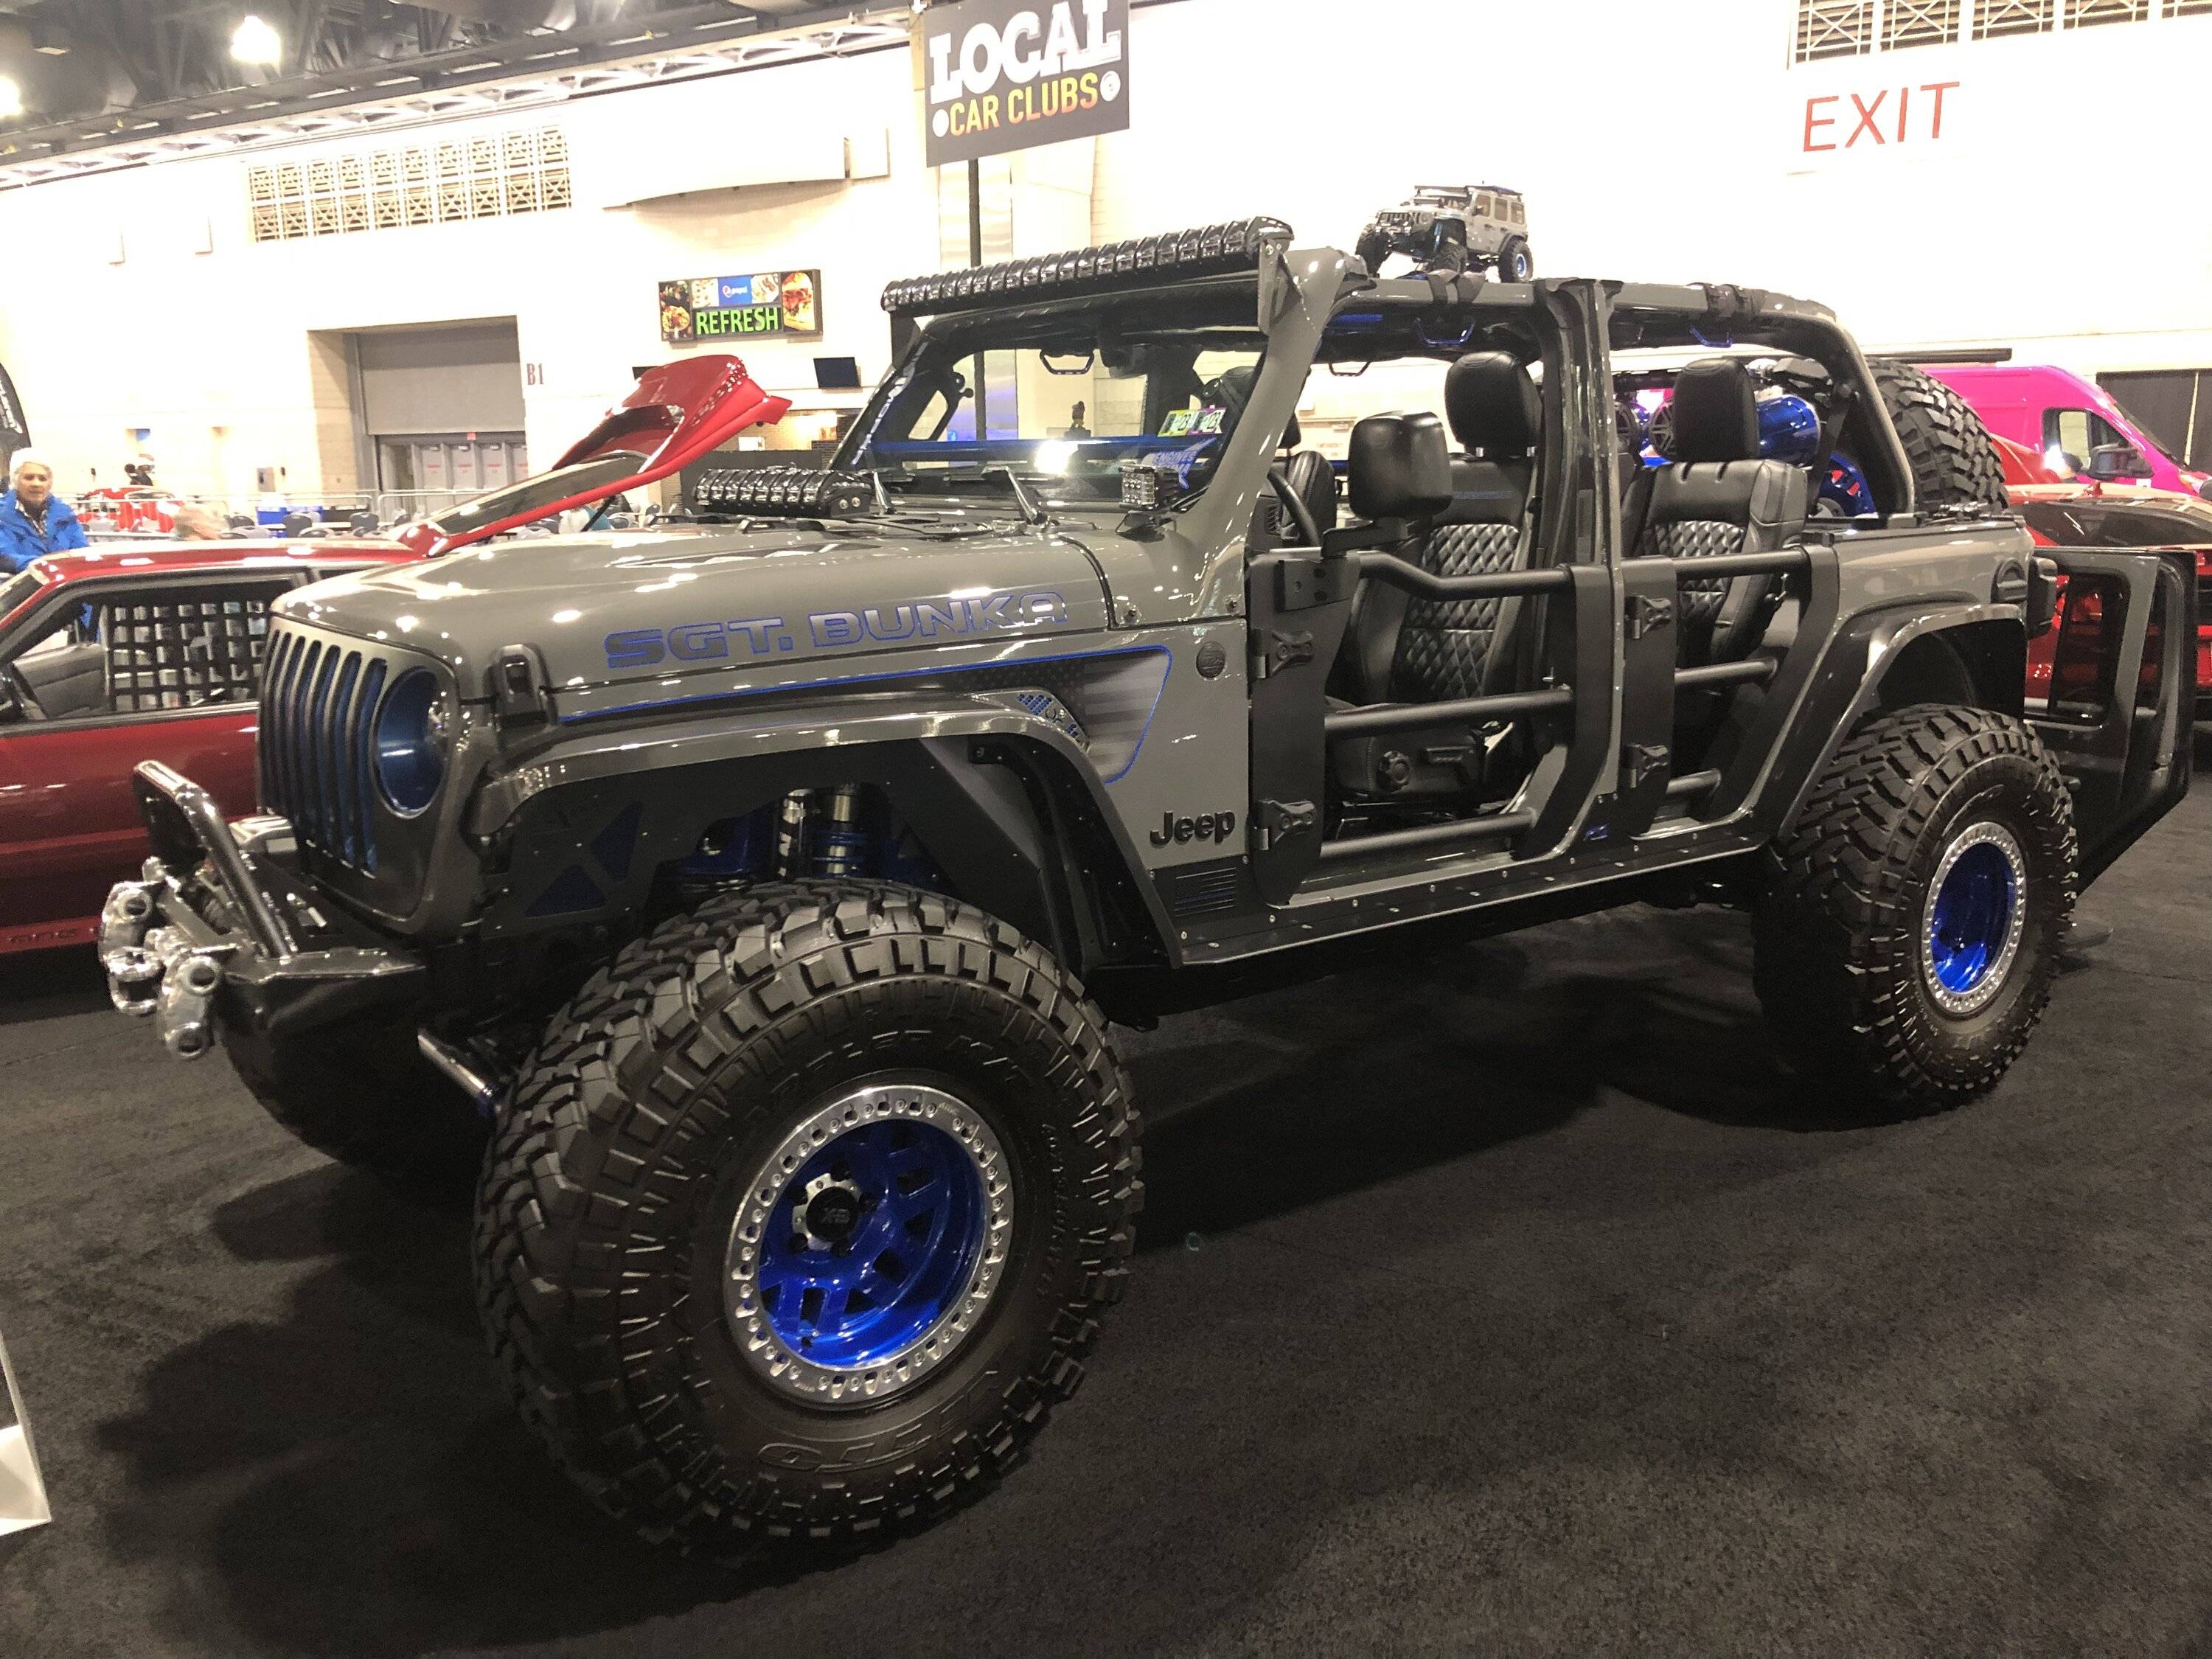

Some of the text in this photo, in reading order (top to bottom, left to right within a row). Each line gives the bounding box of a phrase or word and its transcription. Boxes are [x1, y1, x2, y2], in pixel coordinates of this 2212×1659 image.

[929, 0, 1121, 104] LOCAL
[950, 72, 1099, 136] CAR CLUBS
[1804, 81, 1960, 152] EXIT
[696, 306, 779, 335] REFRESH
[526, 363, 544, 385] B1
[604, 591, 1068, 668] SGT. BUNKA
[1150, 810, 1236, 846] Jeep
